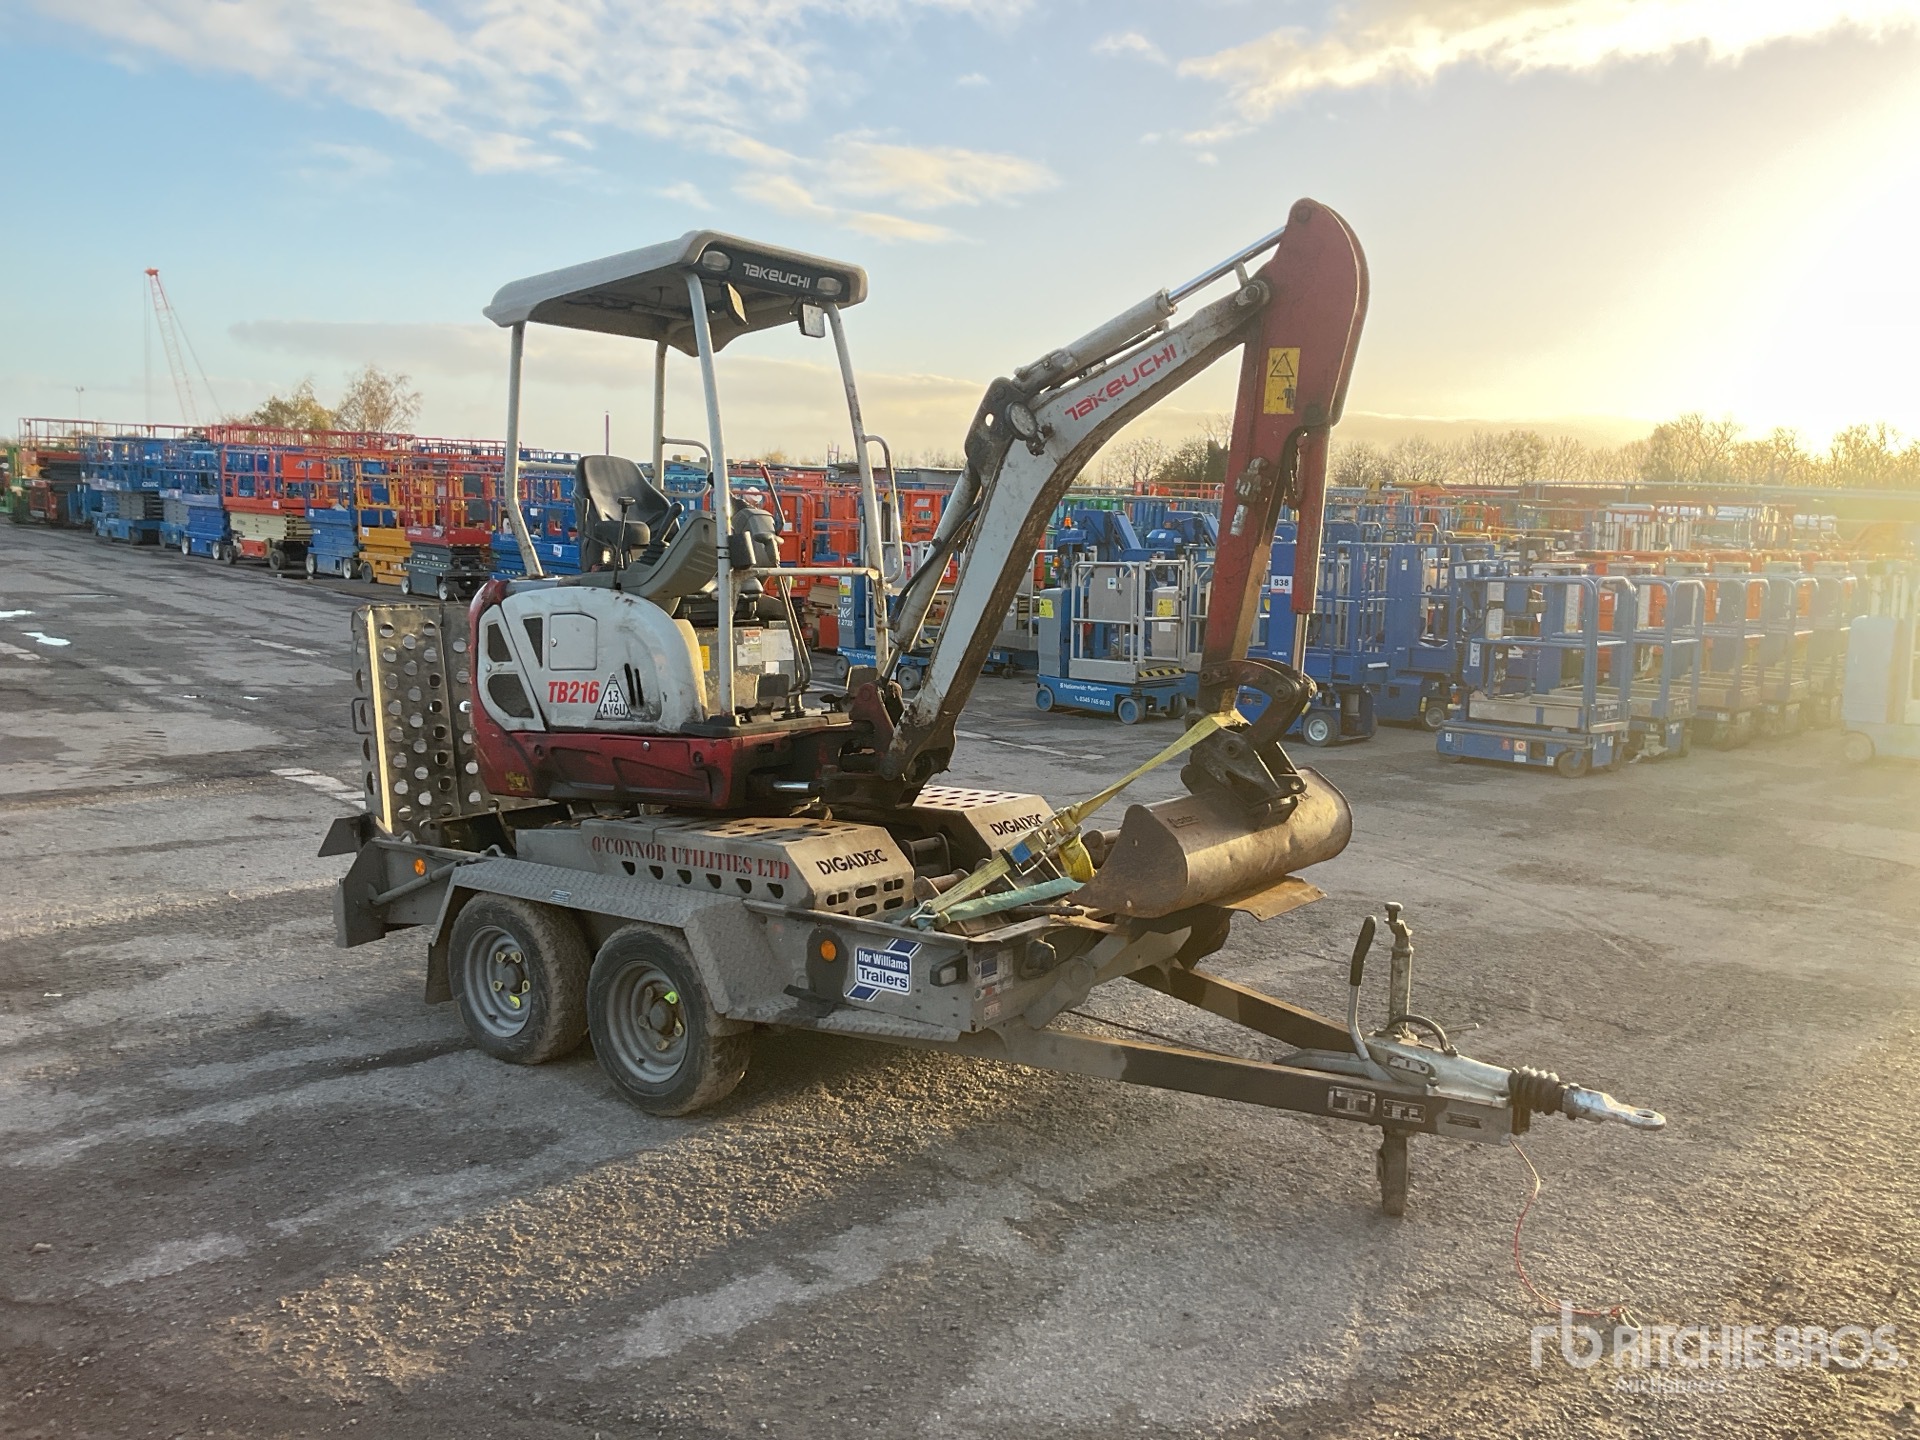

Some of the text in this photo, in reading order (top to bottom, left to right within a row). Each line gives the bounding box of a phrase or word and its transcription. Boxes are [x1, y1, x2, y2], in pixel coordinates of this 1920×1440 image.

[742, 262, 811, 289] TAKEUCHI
[1064, 343, 1178, 421] TAKEUCHI
[1273, 578, 1290, 587] 838
[548, 681, 600, 704] TB216
[607, 690, 620, 703] 13
[592, 835, 790, 880] O'CONNOR UTILITIES LTD
[815, 848, 888, 875] DIGADOC
[858, 950, 909, 971] Ifor Williams
[858, 966, 908, 988] Trailers
